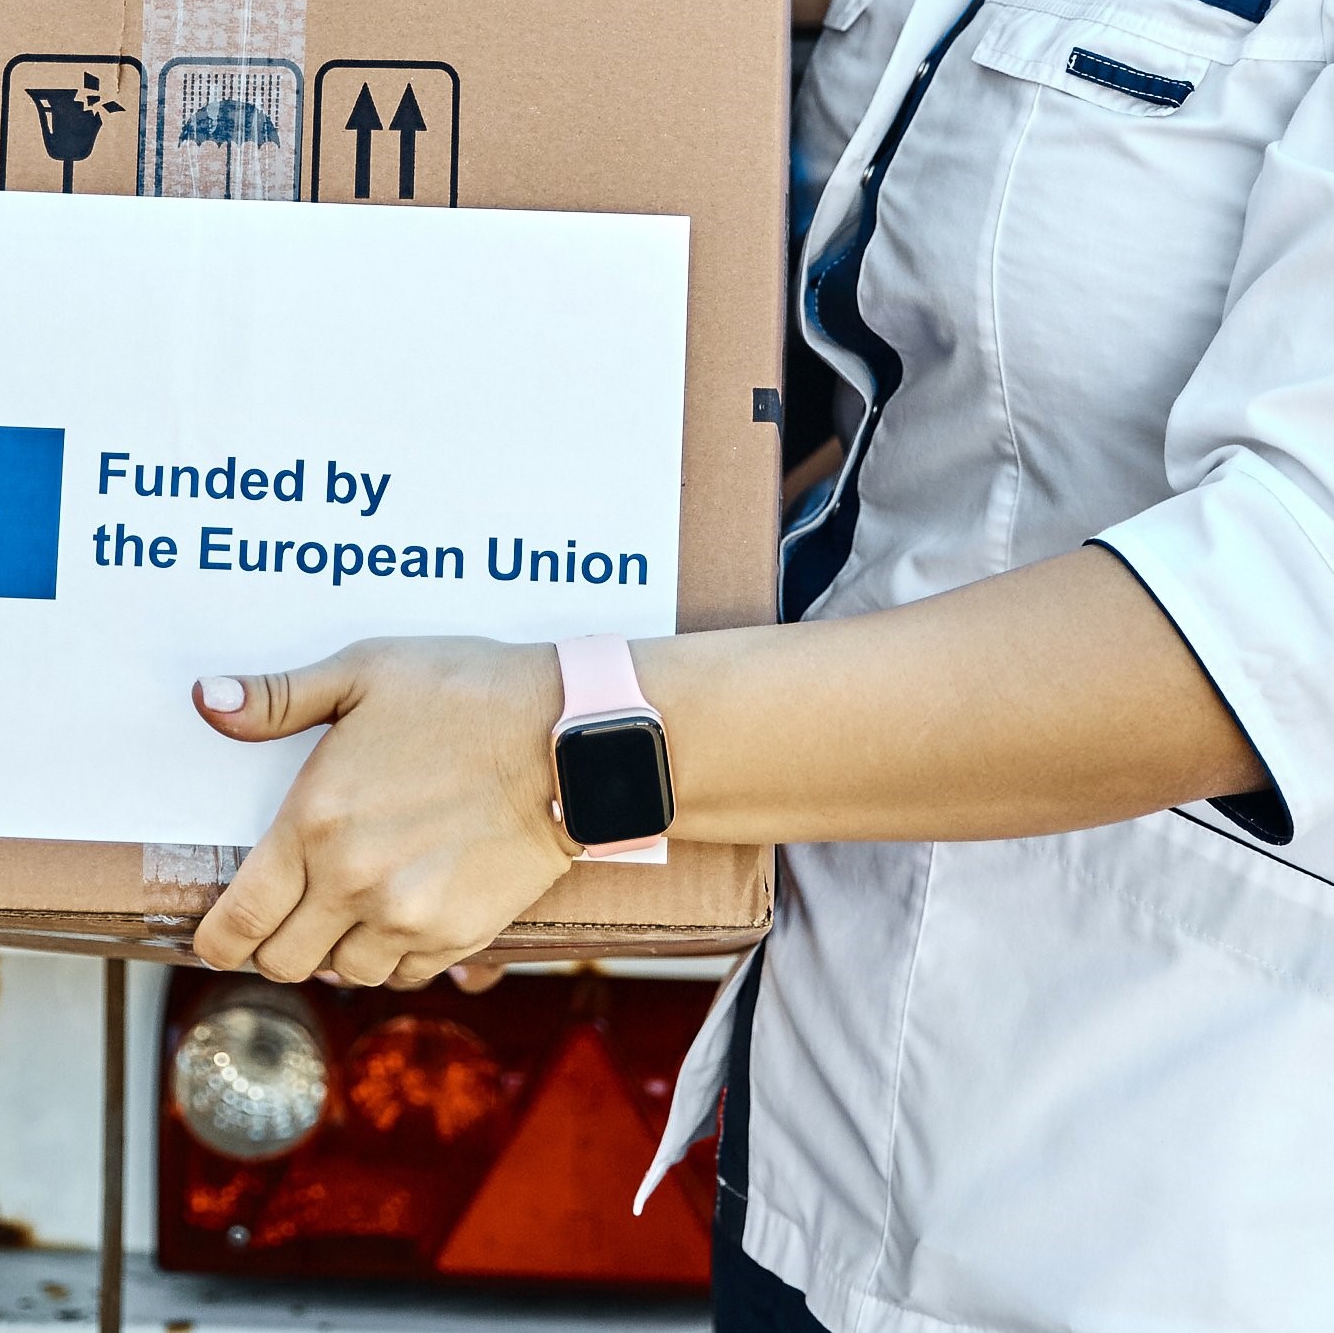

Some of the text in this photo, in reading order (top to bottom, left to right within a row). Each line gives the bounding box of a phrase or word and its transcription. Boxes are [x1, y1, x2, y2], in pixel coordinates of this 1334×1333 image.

[98, 451, 391, 517] Funded by
[93, 523, 649, 587] the European Union
